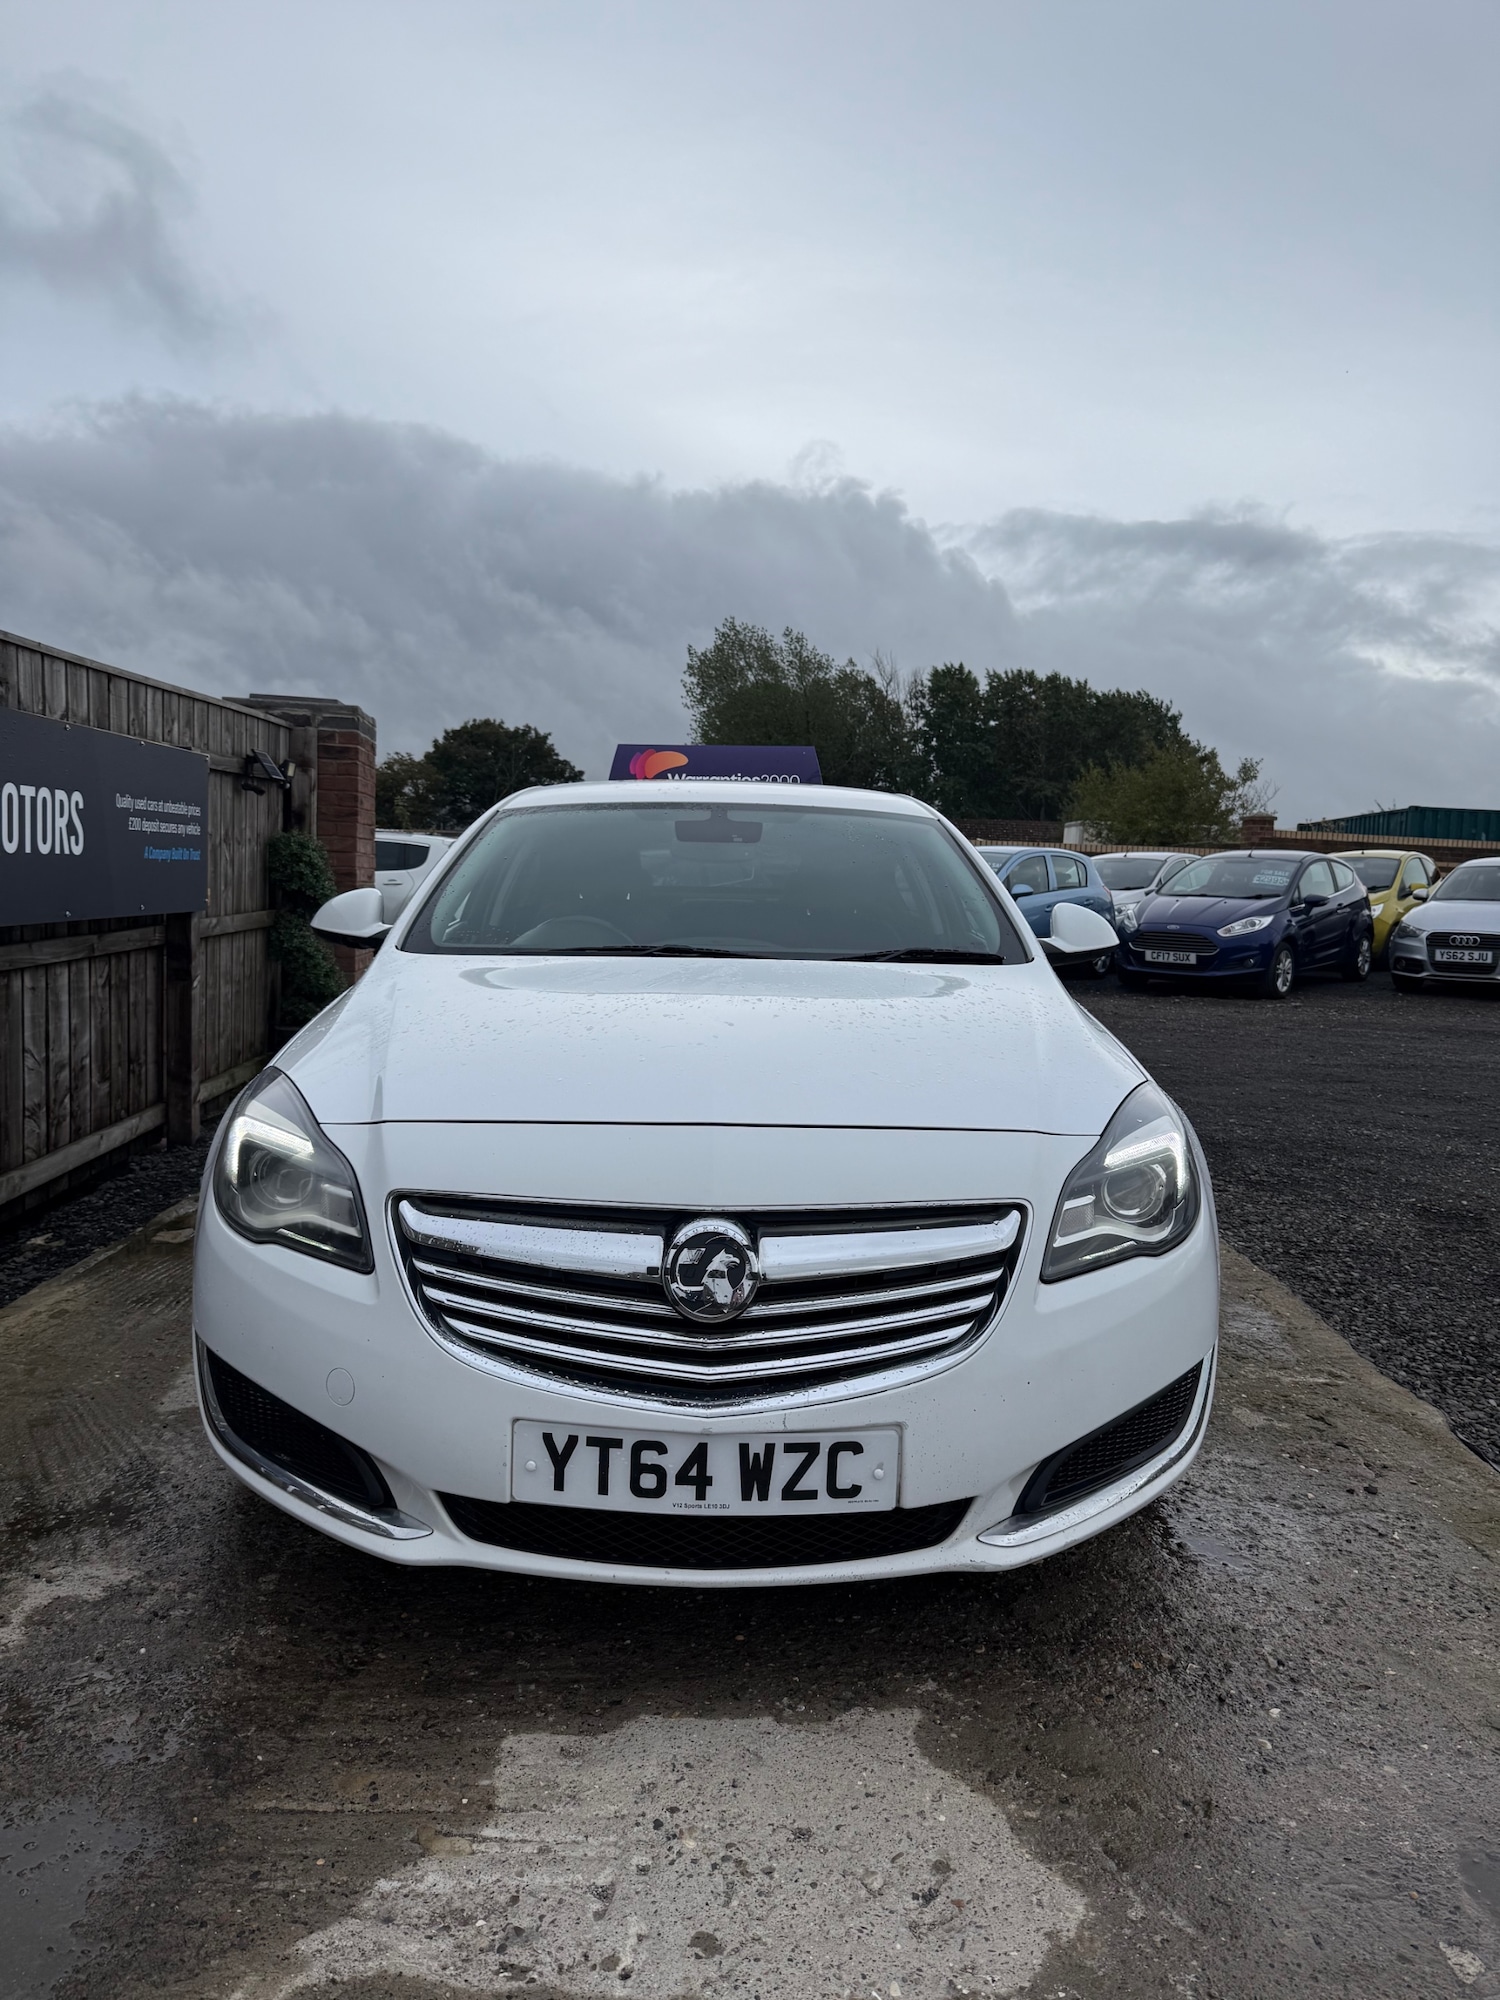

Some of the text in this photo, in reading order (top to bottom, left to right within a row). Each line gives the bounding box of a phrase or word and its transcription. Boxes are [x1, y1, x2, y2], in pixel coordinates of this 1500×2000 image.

[116, 793, 201, 818] Quality used cars at unbeatable prices
[2, 782, 84, 856] OTORS
[128, 817, 201, 837] £200 deposit secures any vehicle
[148, 846, 172, 862] Company
[171, 847, 183, 860] Built
[183, 848, 189, 860] On
[189, 848, 201, 860] Trust
[1151, 951, 1191, 962] CF17 SUX
[1439, 950, 1488, 962] YS62 SJU
[542, 1432, 864, 1501] YT64 WZC
